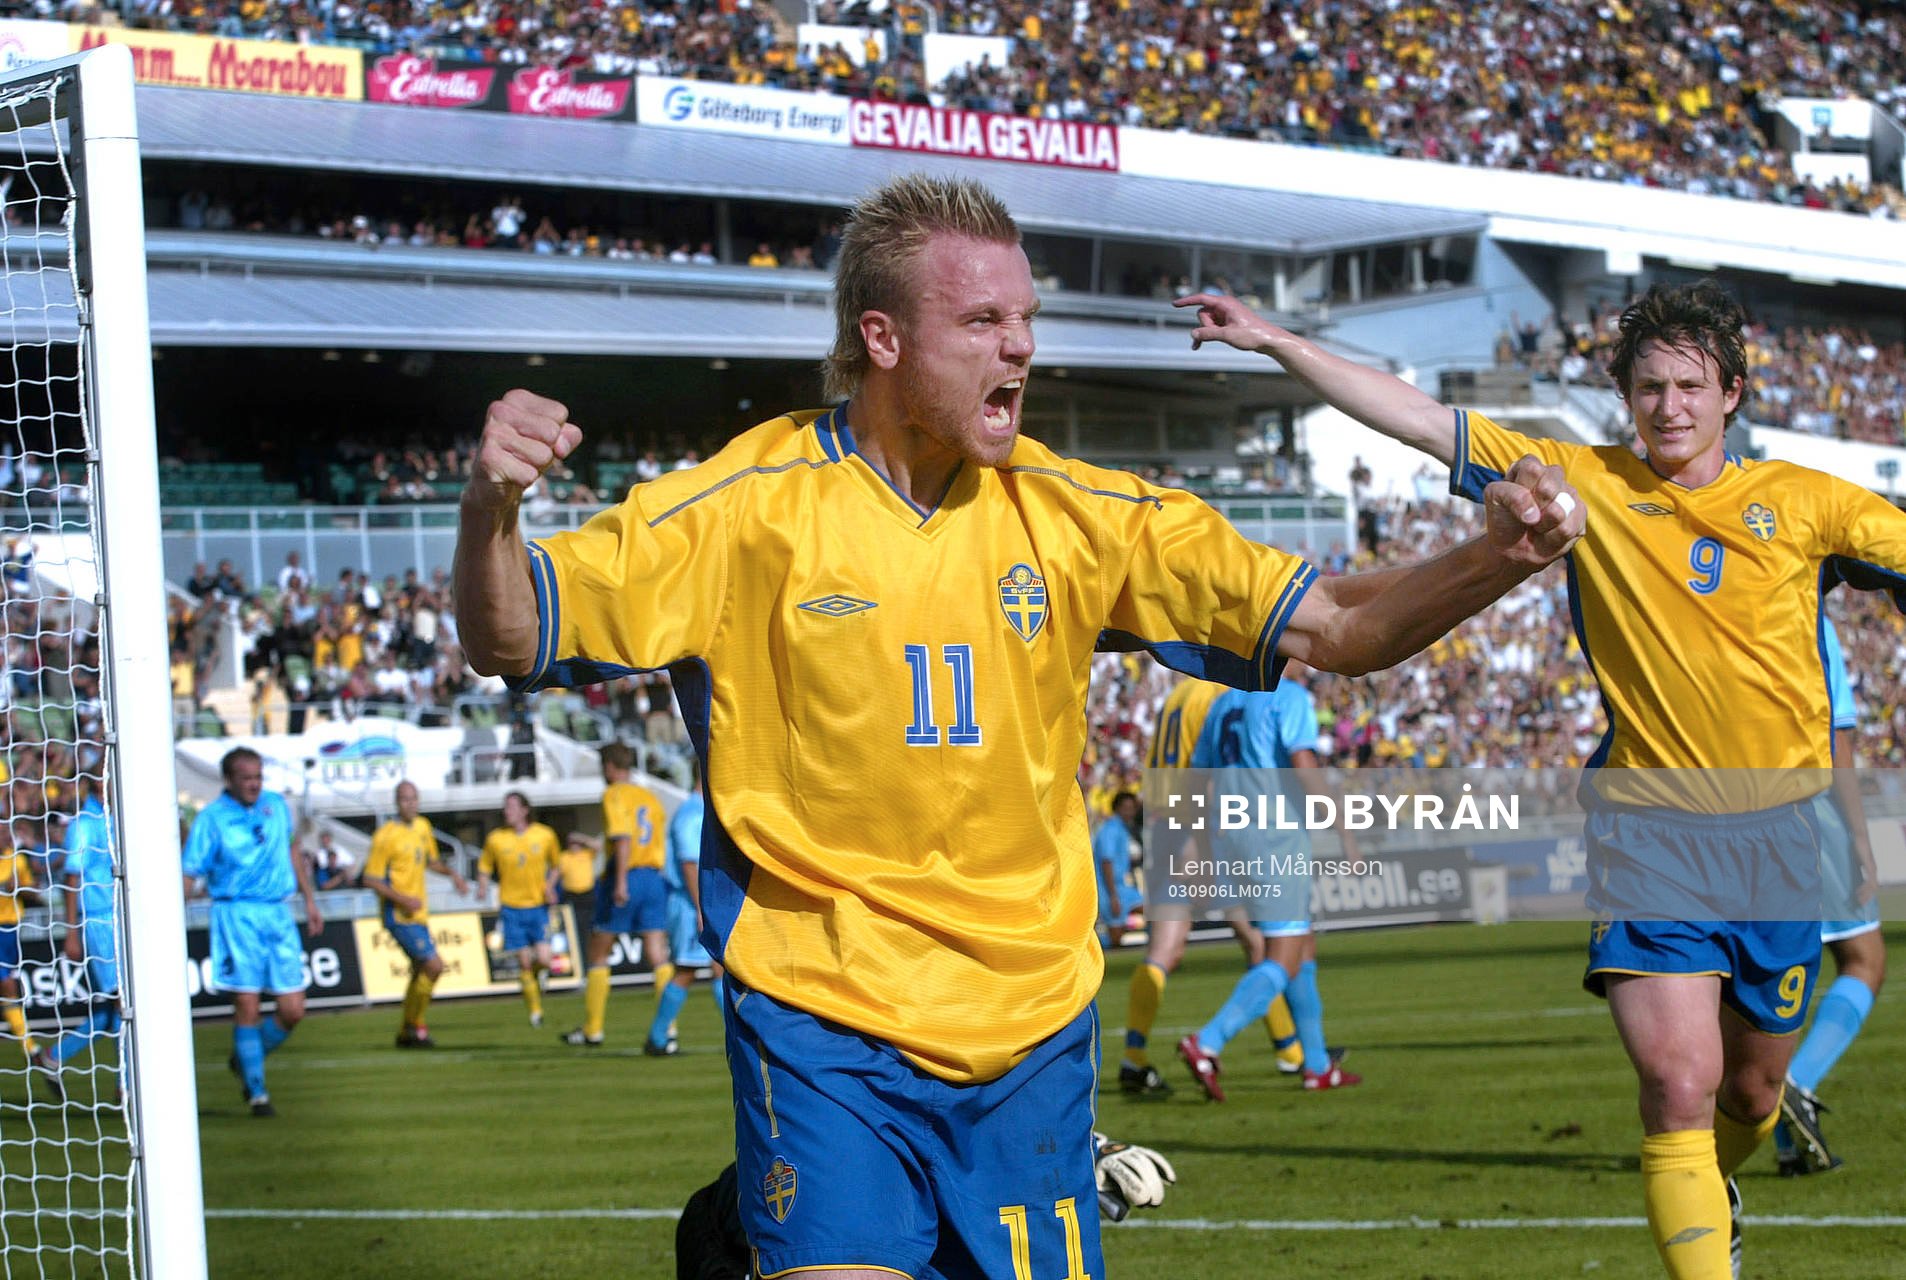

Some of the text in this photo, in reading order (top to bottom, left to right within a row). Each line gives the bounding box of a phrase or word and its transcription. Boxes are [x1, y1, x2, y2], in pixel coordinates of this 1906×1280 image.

[208, 41, 347, 96] Marabou
[389, 57, 480, 100] Estrella
[528, 69, 617, 112] Estrella
[700, 96, 783, 129] Göteborg
[853, 100, 1117, 168] GEVALIA GEVALIA
[1688, 536, 1726, 595] 9
[904, 643, 983, 747] 11
[1218, 707, 1245, 767] 6
[637, 804, 653, 846] 5
[1774, 965, 1806, 1018] 9
[999, 1196, 1092, 1280] 11
